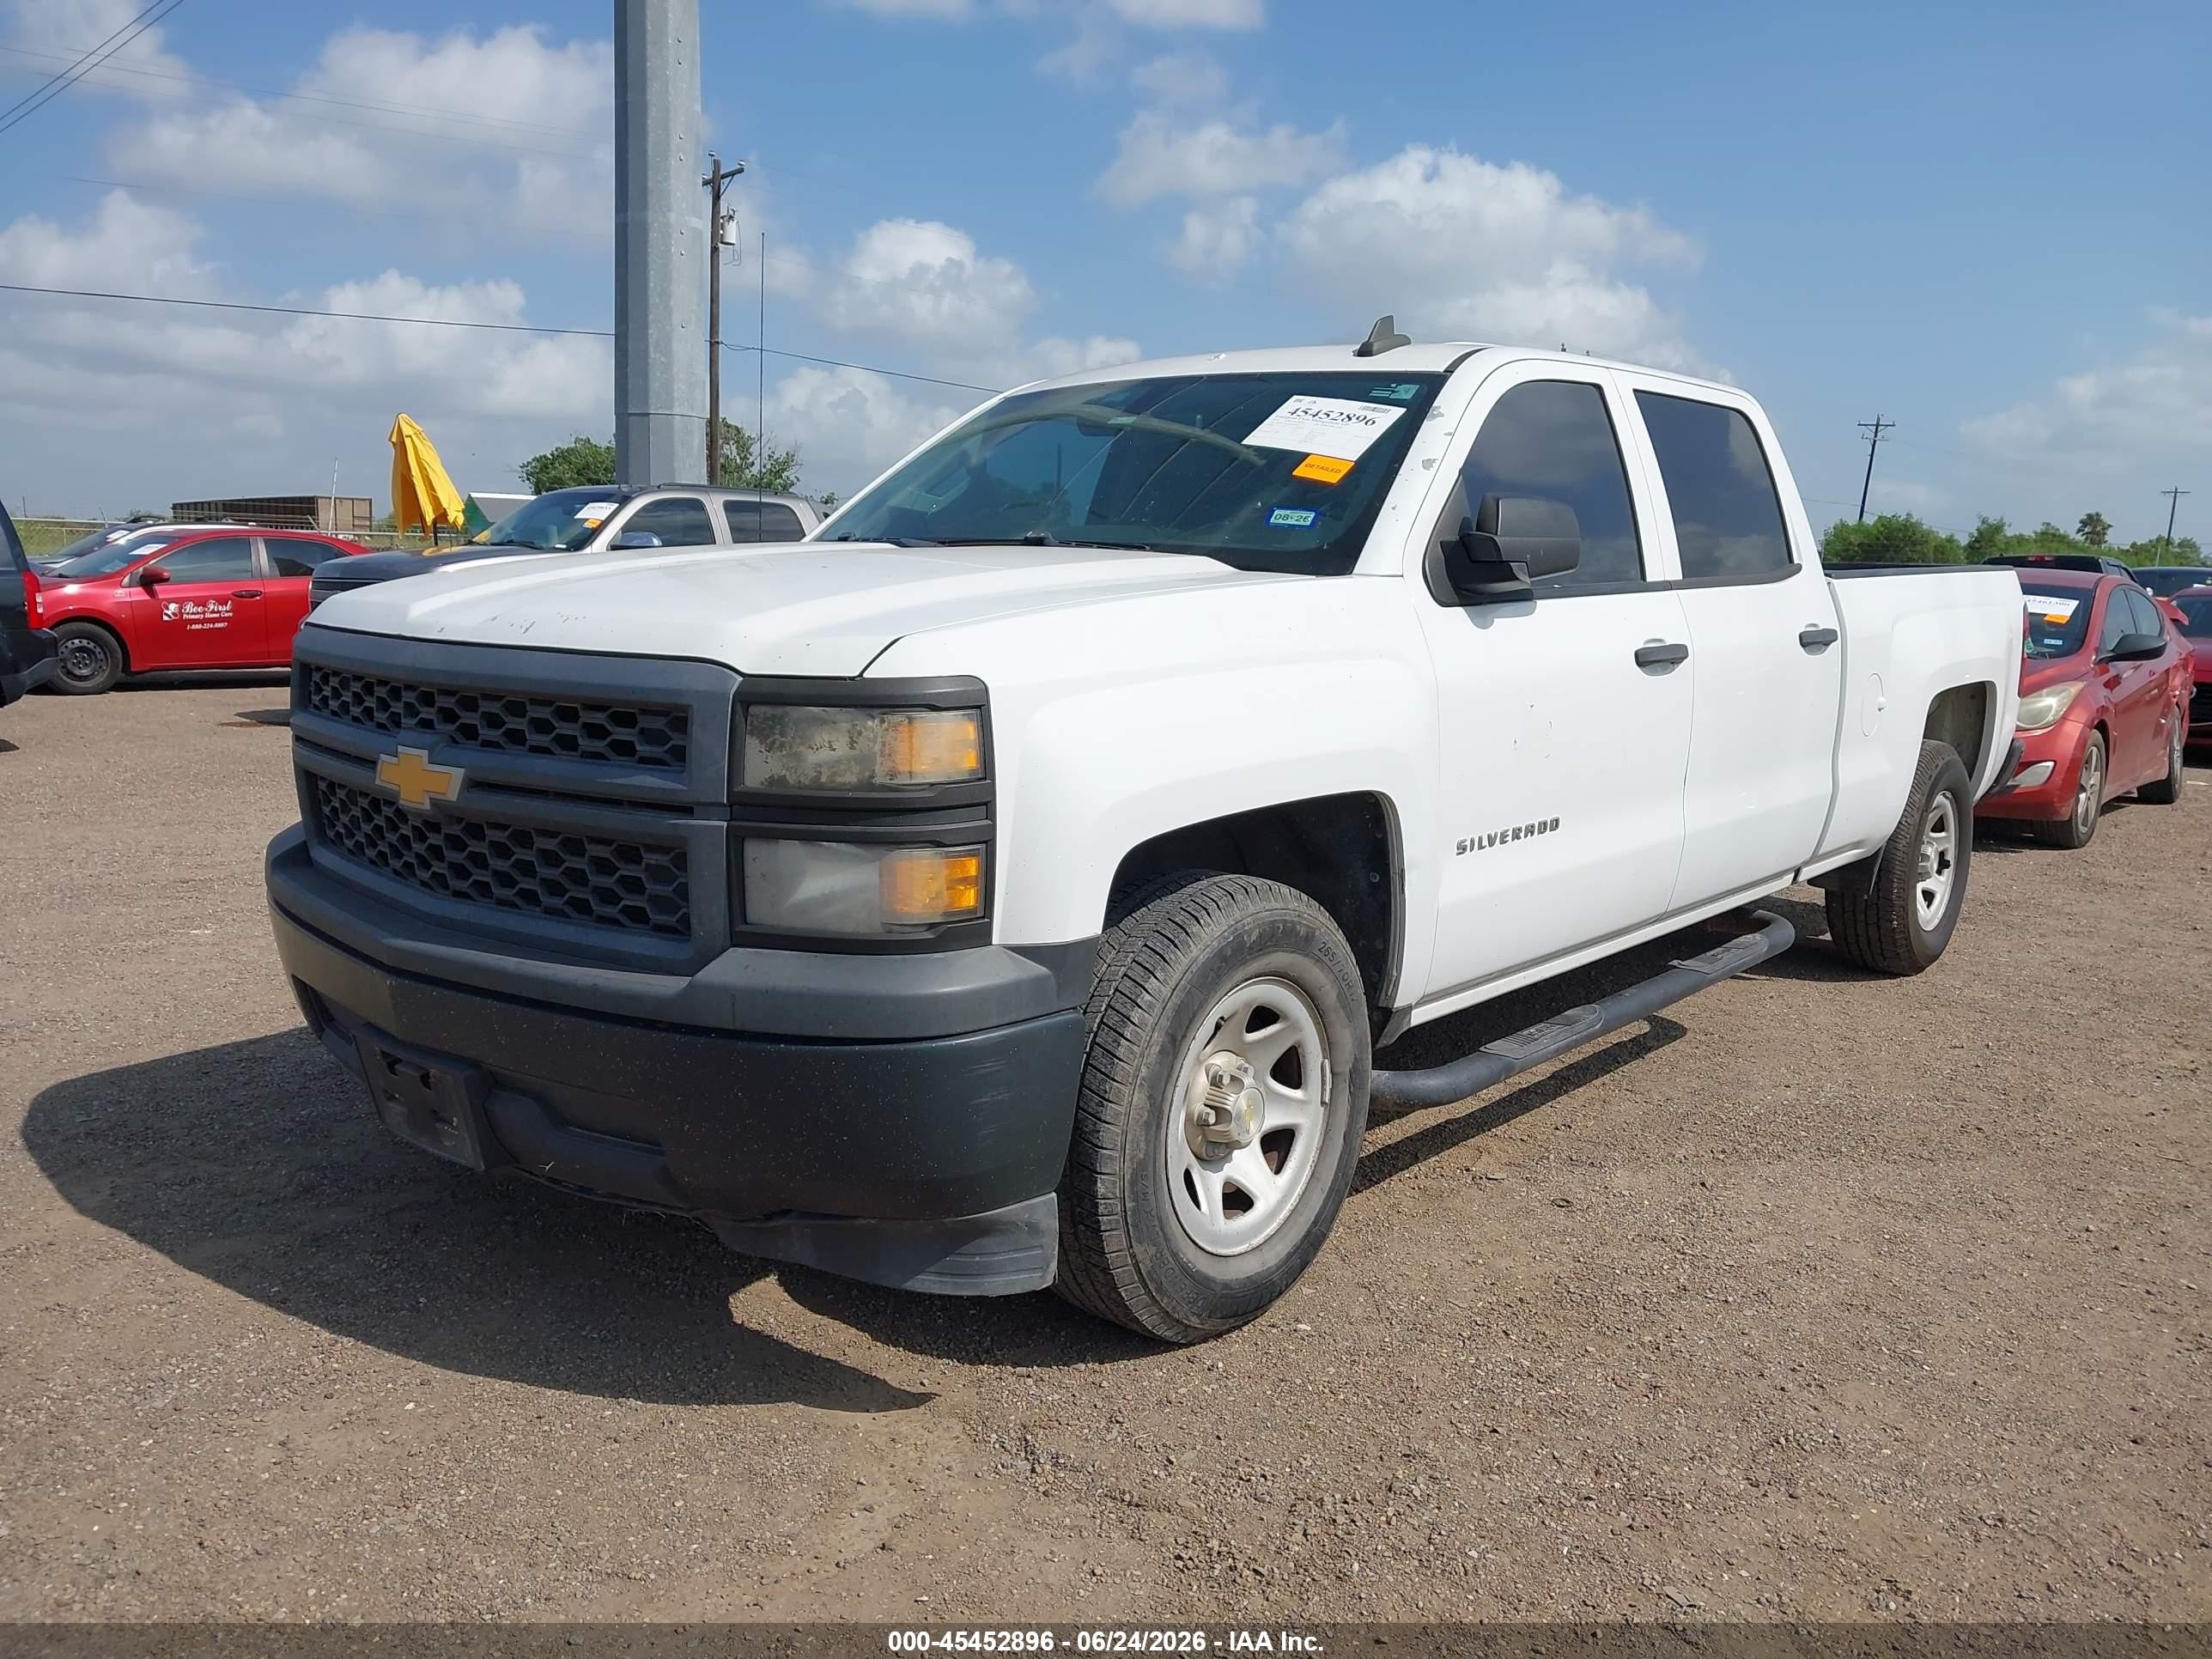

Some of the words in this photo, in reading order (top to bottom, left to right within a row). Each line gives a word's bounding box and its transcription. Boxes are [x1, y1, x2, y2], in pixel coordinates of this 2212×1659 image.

[1287, 406, 1381, 427] 45452896
[1304, 463, 1342, 474] DETAILED
[181, 601, 204, 613] Bee
[204, 599, 233, 612] First
[1455, 816, 1560, 856] SILVERADO
